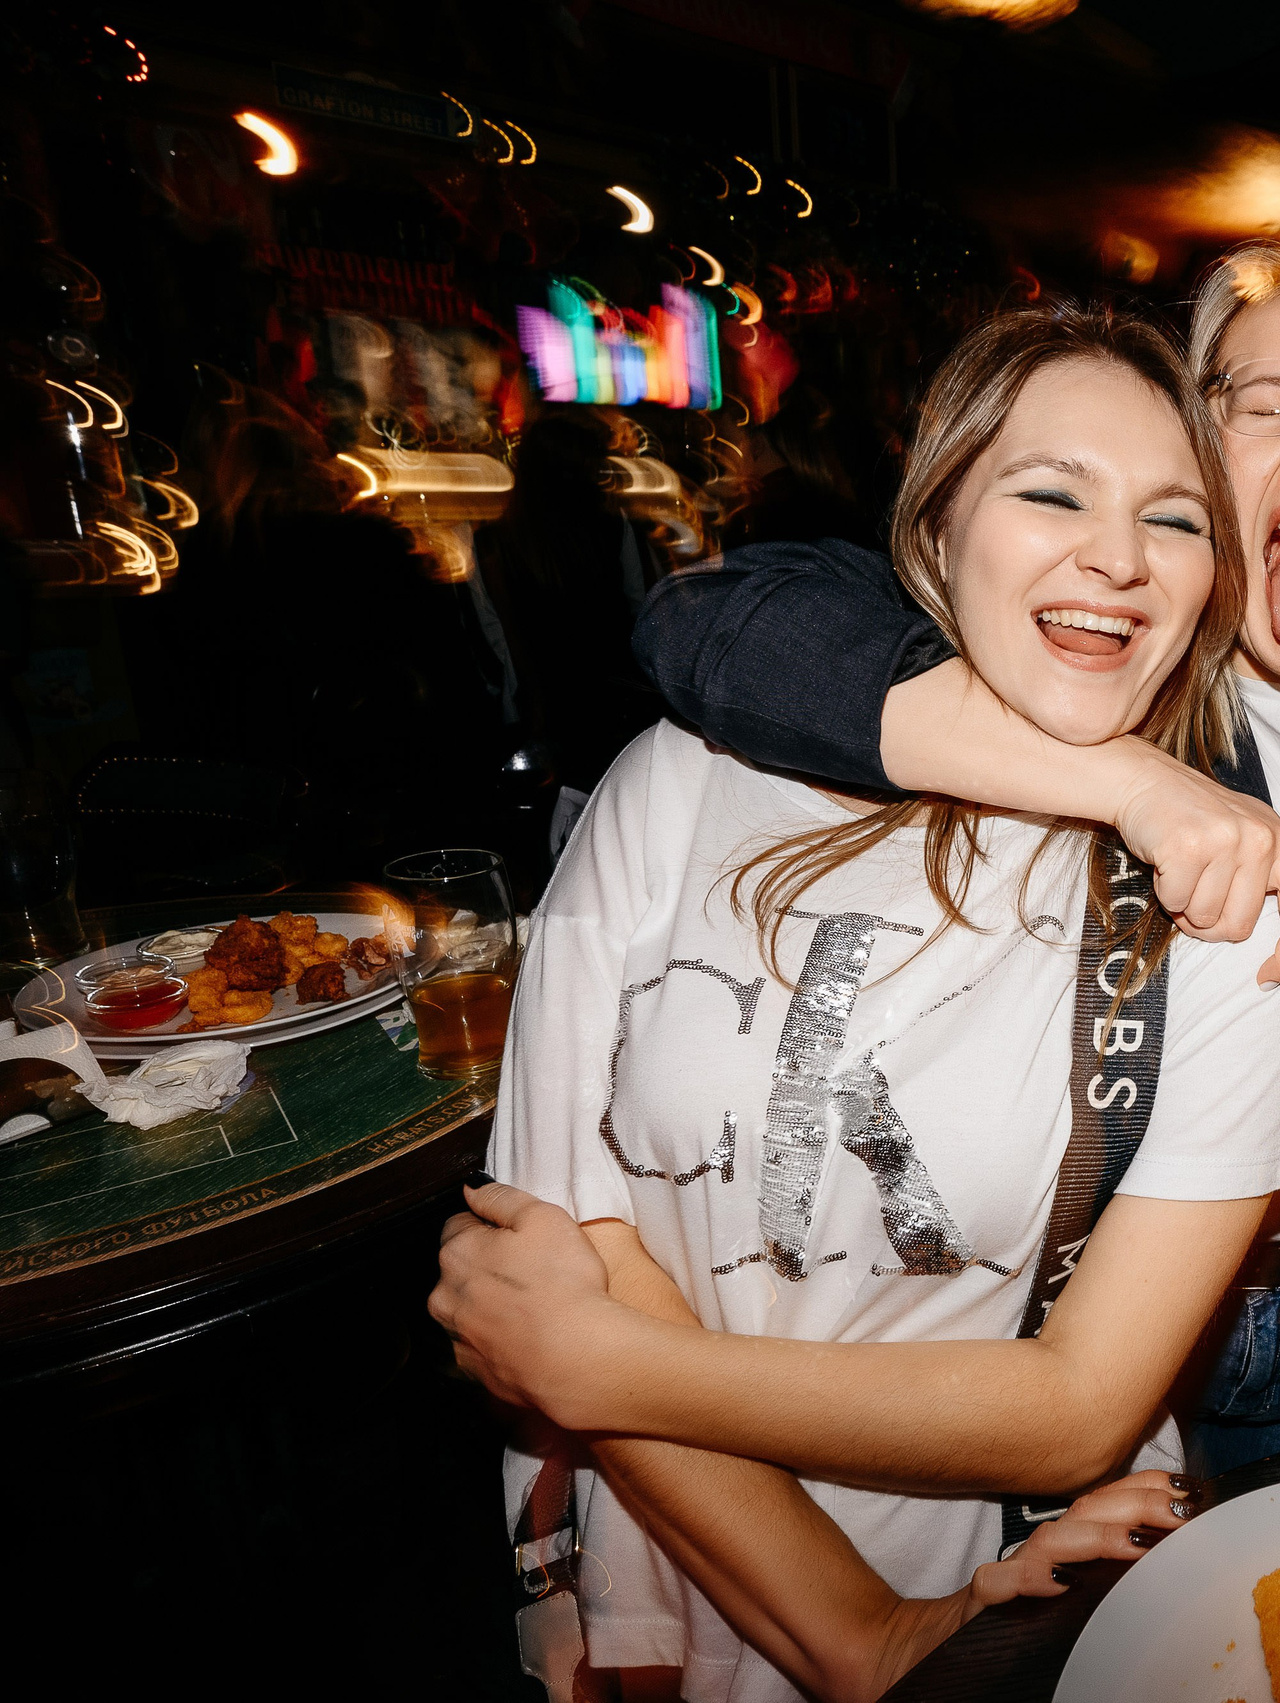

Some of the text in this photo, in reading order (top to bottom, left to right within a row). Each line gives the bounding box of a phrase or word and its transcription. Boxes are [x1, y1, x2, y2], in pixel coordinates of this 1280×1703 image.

[283, 86, 375, 119] GRAFTON
[379, 106, 443, 135] STREET
[140, 1187, 279, 1236] ФУТБОЛА
